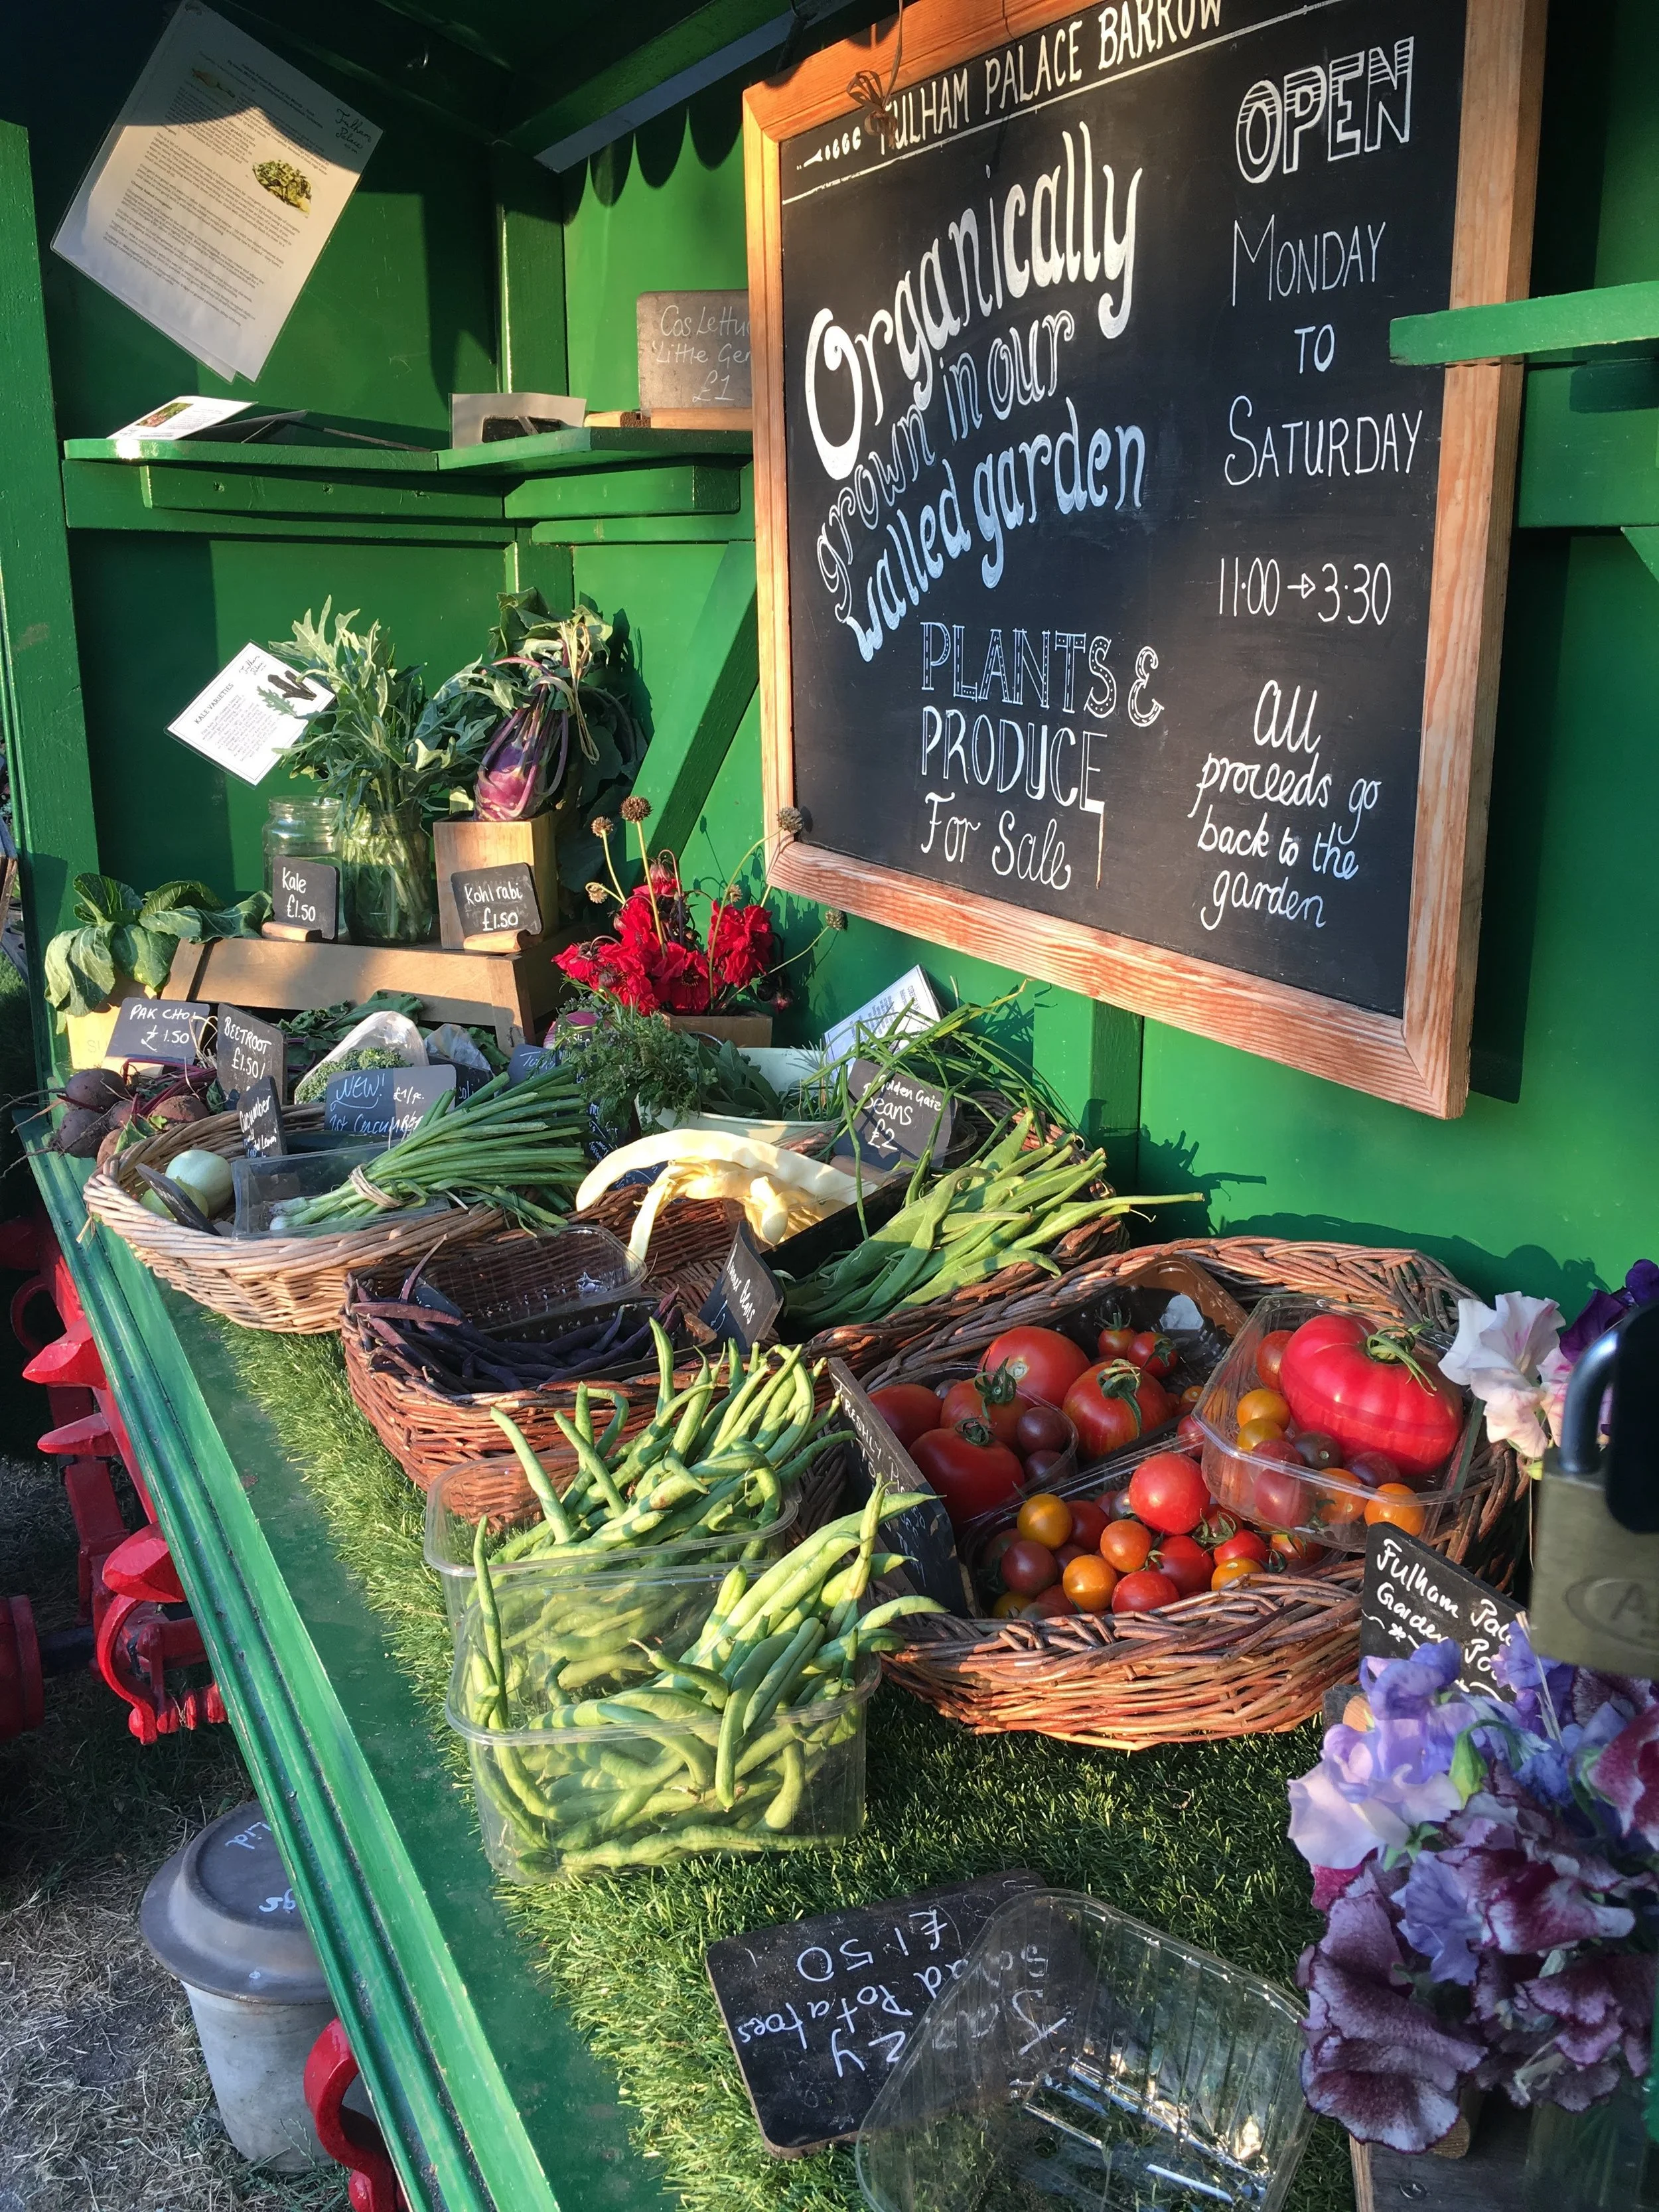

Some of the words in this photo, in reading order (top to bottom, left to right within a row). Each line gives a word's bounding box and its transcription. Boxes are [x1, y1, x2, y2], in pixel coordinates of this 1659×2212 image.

[881, 68, 970, 155] ULHAM
[985, 21, 1083, 115] PALACE
[1236, 36, 1414, 184] OPEN
[1232, 214, 1386, 307] MONDAY
[660, 305, 692, 336] Cos
[696, 306, 751, 336] Lettu
[805, 121, 1143, 479] Organically
[1295, 324, 1335, 374] TO
[692, 370, 735, 402] £1
[817, 402, 935, 623] grown
[940, 351, 983, 445] in
[987, 310, 1074, 421] our
[1224, 396, 1423, 485] SATURDAY
[847, 459, 971, 662] walled
[974, 396, 1145, 589] garden
[194, 707, 210, 725] KALE
[206, 683, 234, 710] VARIETIES
[920, 621, 1117, 719] PLANTS
[1128, 646, 1165, 727] &
[922, 705, 1109, 814] PRODUCE
[1187, 752, 1332, 818] proceeds
[1338, 777, 1382, 845] go
[922, 791, 981, 863] For
[991, 810, 1072, 891] Sale
[1196, 804, 1269, 857] back
[1278, 834, 1299, 866] to
[1313, 822, 1359, 878] the
[282, 867, 307, 893] Kale
[287, 894, 316, 922] £1.50
[1200, 869, 1326, 930] garden
[482, 907, 518, 931] £1.50
[129, 1003, 155, 1020] PAK
[224, 1016, 272, 1055] BEETROOT
[239, 1096, 271, 1134] Cucumber
[336, 1073, 385, 1101] NEW!
[867, 1118, 899, 1150] £2
[889, 1456, 926, 1529] PICED
[1376, 1538, 1459, 1619] Fulham
[1470, 1599, 1512, 1647] Pal
[1377, 1582, 1449, 1643] Garden
[737, 1984, 913, 2049] Potatoes
